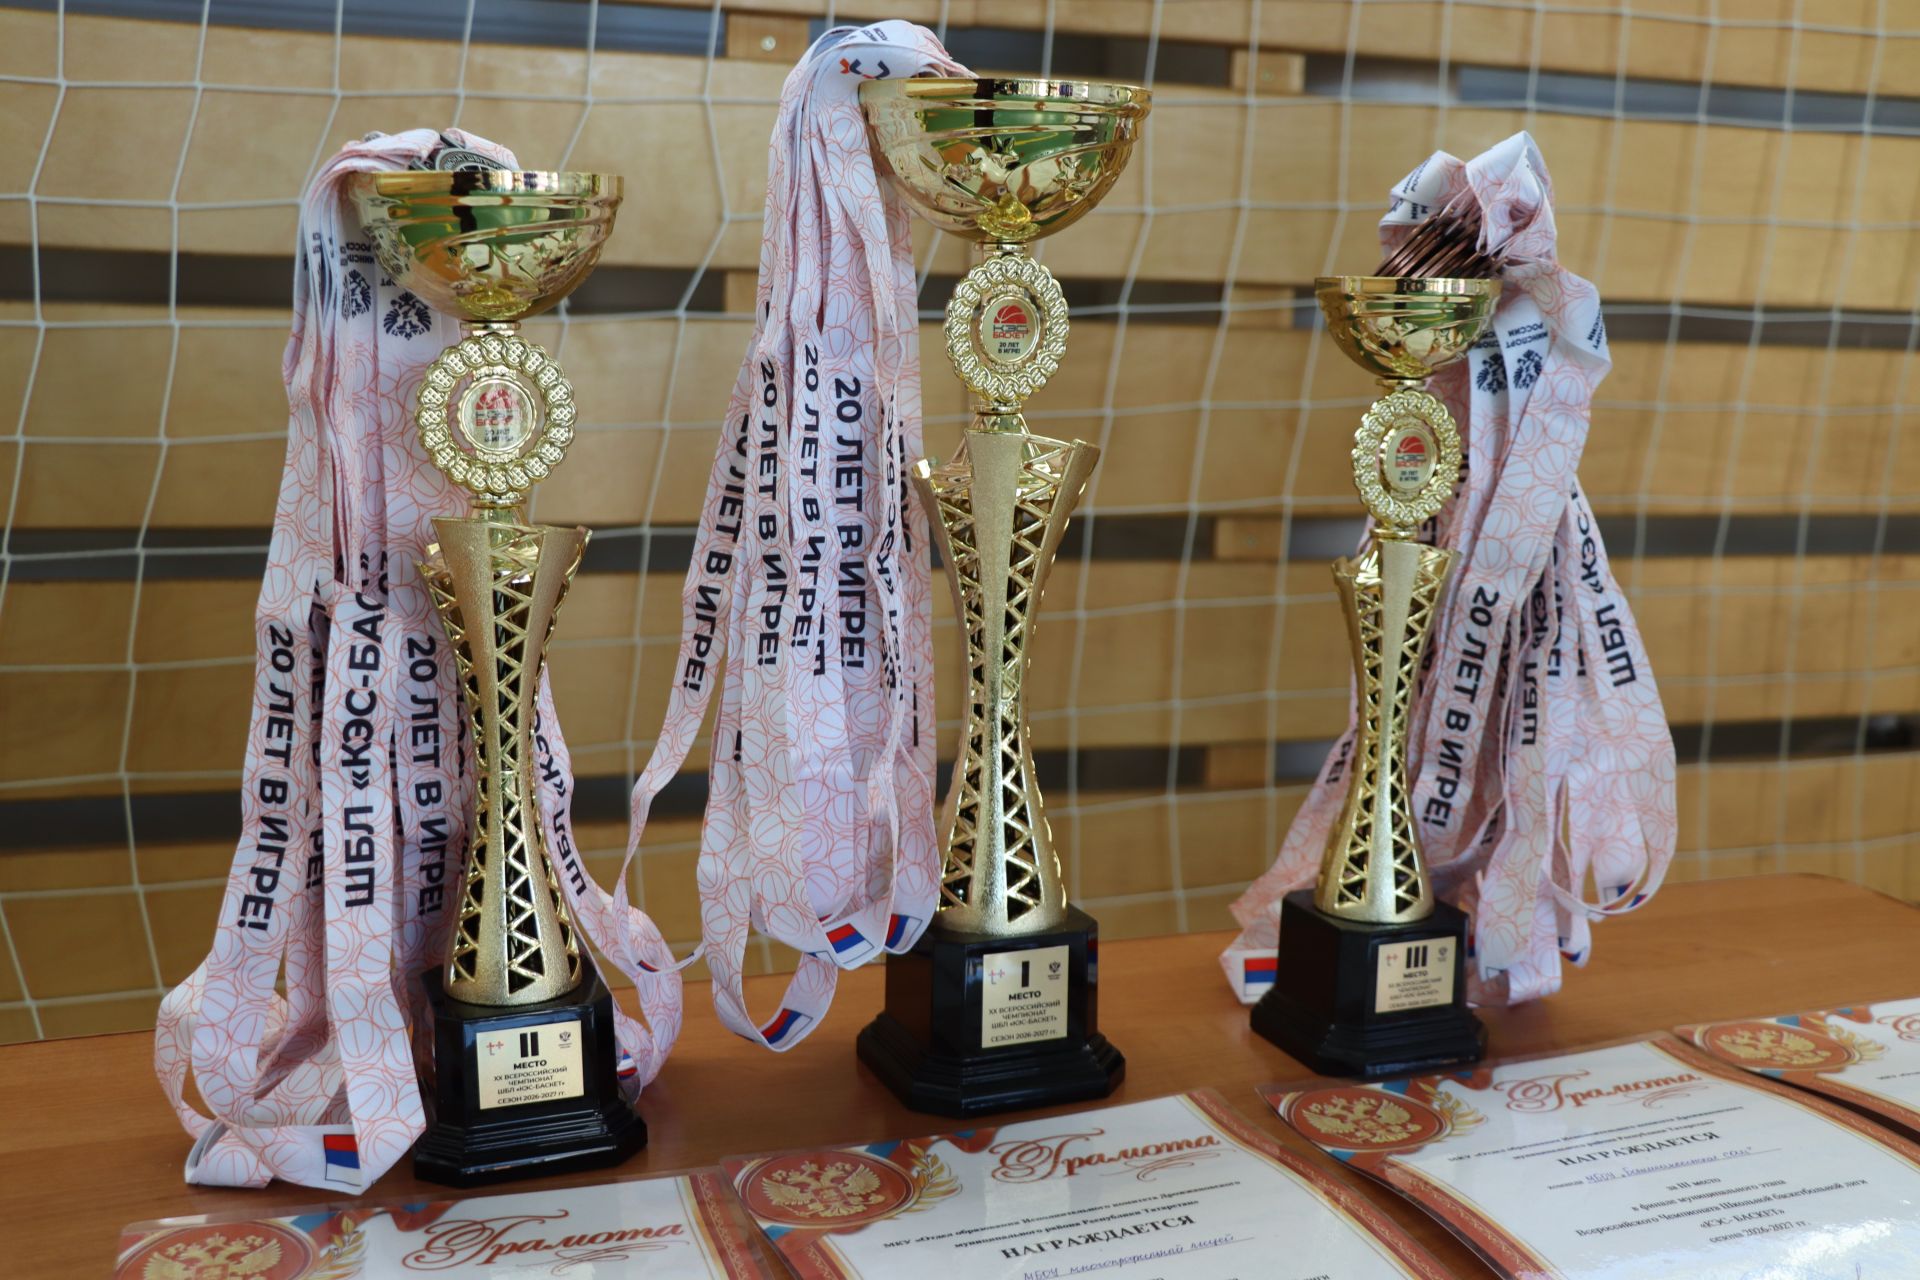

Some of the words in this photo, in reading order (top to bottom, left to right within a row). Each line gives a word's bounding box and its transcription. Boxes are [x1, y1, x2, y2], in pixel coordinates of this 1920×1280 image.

[760, 359, 778, 408] 20
[805, 343, 819, 392] 20
[834, 377, 863, 424] 20
[758, 420, 778, 500] ЛЕТ
[800, 403, 819, 484] ЛЕТ
[835, 434, 864, 513] ЛЕТ
[758, 514, 777, 540] В
[802, 497, 821, 522] В
[837, 525, 863, 549] В
[706, 550, 733, 575] В
[757, 554, 788, 666] ИГРЕ!
[791, 536, 826, 648] ИГРЕ!
[838, 561, 866, 668] ИГРЕ!
[1470, 586, 1499, 627] 20
[269, 624, 295, 674] 20
[406, 635, 438, 683] 20
[683, 584, 722, 692] ИГРЕ!
[1595, 603, 1637, 687] ШБЛ
[1453, 632, 1487, 704] ЛЕТ
[263, 682, 295, 768] ЛЕТ
[1445, 708, 1471, 732] В
[1521, 662, 1538, 745] ШБЛ
[410, 694, 441, 768] ЛЕТ
[259, 778, 289, 805] В
[414, 780, 443, 808] В
[1422, 738, 1464, 828] ИГРЕ!
[237, 814, 289, 932] ИГРЕ!
[344, 805, 376, 907] ШБЛ
[418, 817, 448, 917] ИГРЕ!
[554, 808, 588, 896] ШБЛ
[1021, 960, 1030, 988] I
[1405, 945, 1428, 969] III
[999, 1000, 1061, 1014] ВСЕРОССИЙСКИЙ
[1002, 1009, 1047, 1020] ЧЕМПИОНАТ
[1008, 990, 1042, 1001] МЕСТО
[519, 1031, 540, 1058] II
[991, 1034, 1014, 1043] СЕЗОН
[504, 1065, 568, 1081] ВСЕРОССИЙСКИЙ
[508, 1075, 554, 1086] ЧЕМПИОНАТ
[513, 1059, 547, 1070] МЕСТО
[497, 1087, 515, 1095] ШБЛ
[497, 1096, 522, 1105] СЕЗОН
[1492, 1068, 1703, 1114] Грамота
[988, 1128, 1236, 1184] Грамота
[1557, 1132, 1722, 1166] НАГРАЖДАЕТСЯ
[1639, 1199, 1678, 1211] финале
[1678, 1185, 1759, 1203] муниципального
[1760, 1178, 1787, 1189] этапа
[1692, 1177, 1722, 1187] место
[954, 1220, 1020, 1237] образования
[1021, 1204, 1111, 1225] Исполнительного
[1111, 1196, 1159, 1209] комитета
[954, 1228, 1043, 1249] муниципального
[1044, 1221, 1081, 1234] района
[1081, 1209, 1142, 1227] Республики
[1575, 1216, 1660, 1237] Всероссийского
[1658, 1203, 1721, 1221] Чемпионата
[1720, 1195, 1775, 1209] Школьной
[1772, 1182, 1845, 1201] баскетбольной
[402, 1208, 690, 1275] Грамота
[1000, 1214, 1197, 1260] НАГРАЖДАЕТСЯ
[1709, 1231, 1744, 1243] сезона
